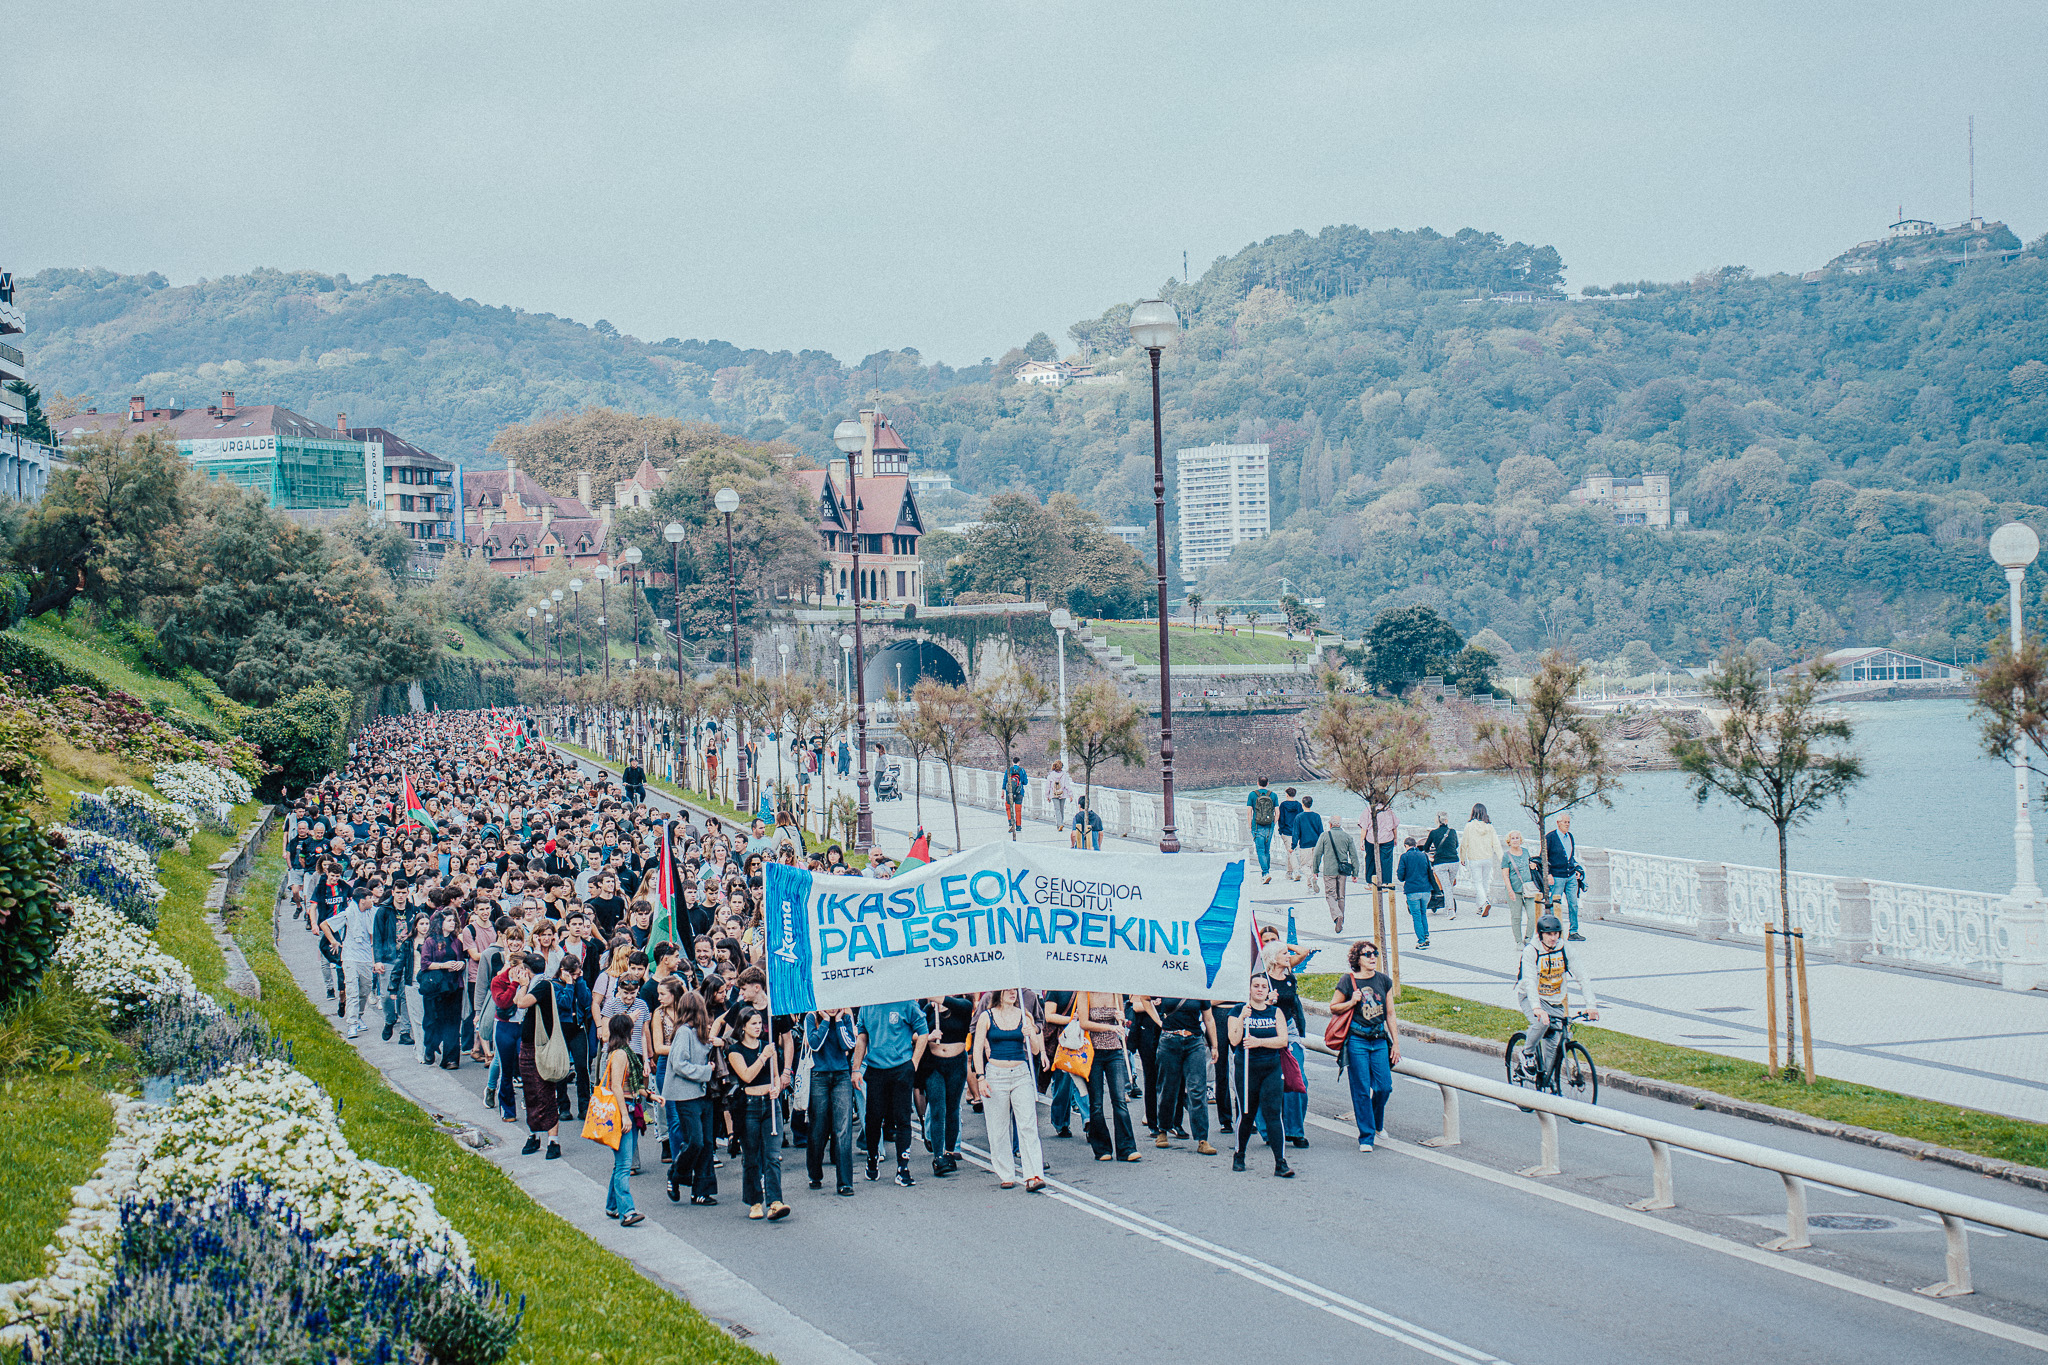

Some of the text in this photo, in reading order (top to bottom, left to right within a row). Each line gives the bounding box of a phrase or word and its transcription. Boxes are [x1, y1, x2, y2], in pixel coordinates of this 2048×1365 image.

[222, 438, 275, 452] URGALDE
[817, 868, 1030, 925] IKASLEOK
[1034, 889, 1113, 911] GELDITU!
[1035, 875, 1142, 900] GENOZIDIOA
[819, 907, 1190, 966] PALESTINAREKIN!
[821, 950, 1189, 980] IBAITIK ITSASORAINO, PALESTINA ASKE
